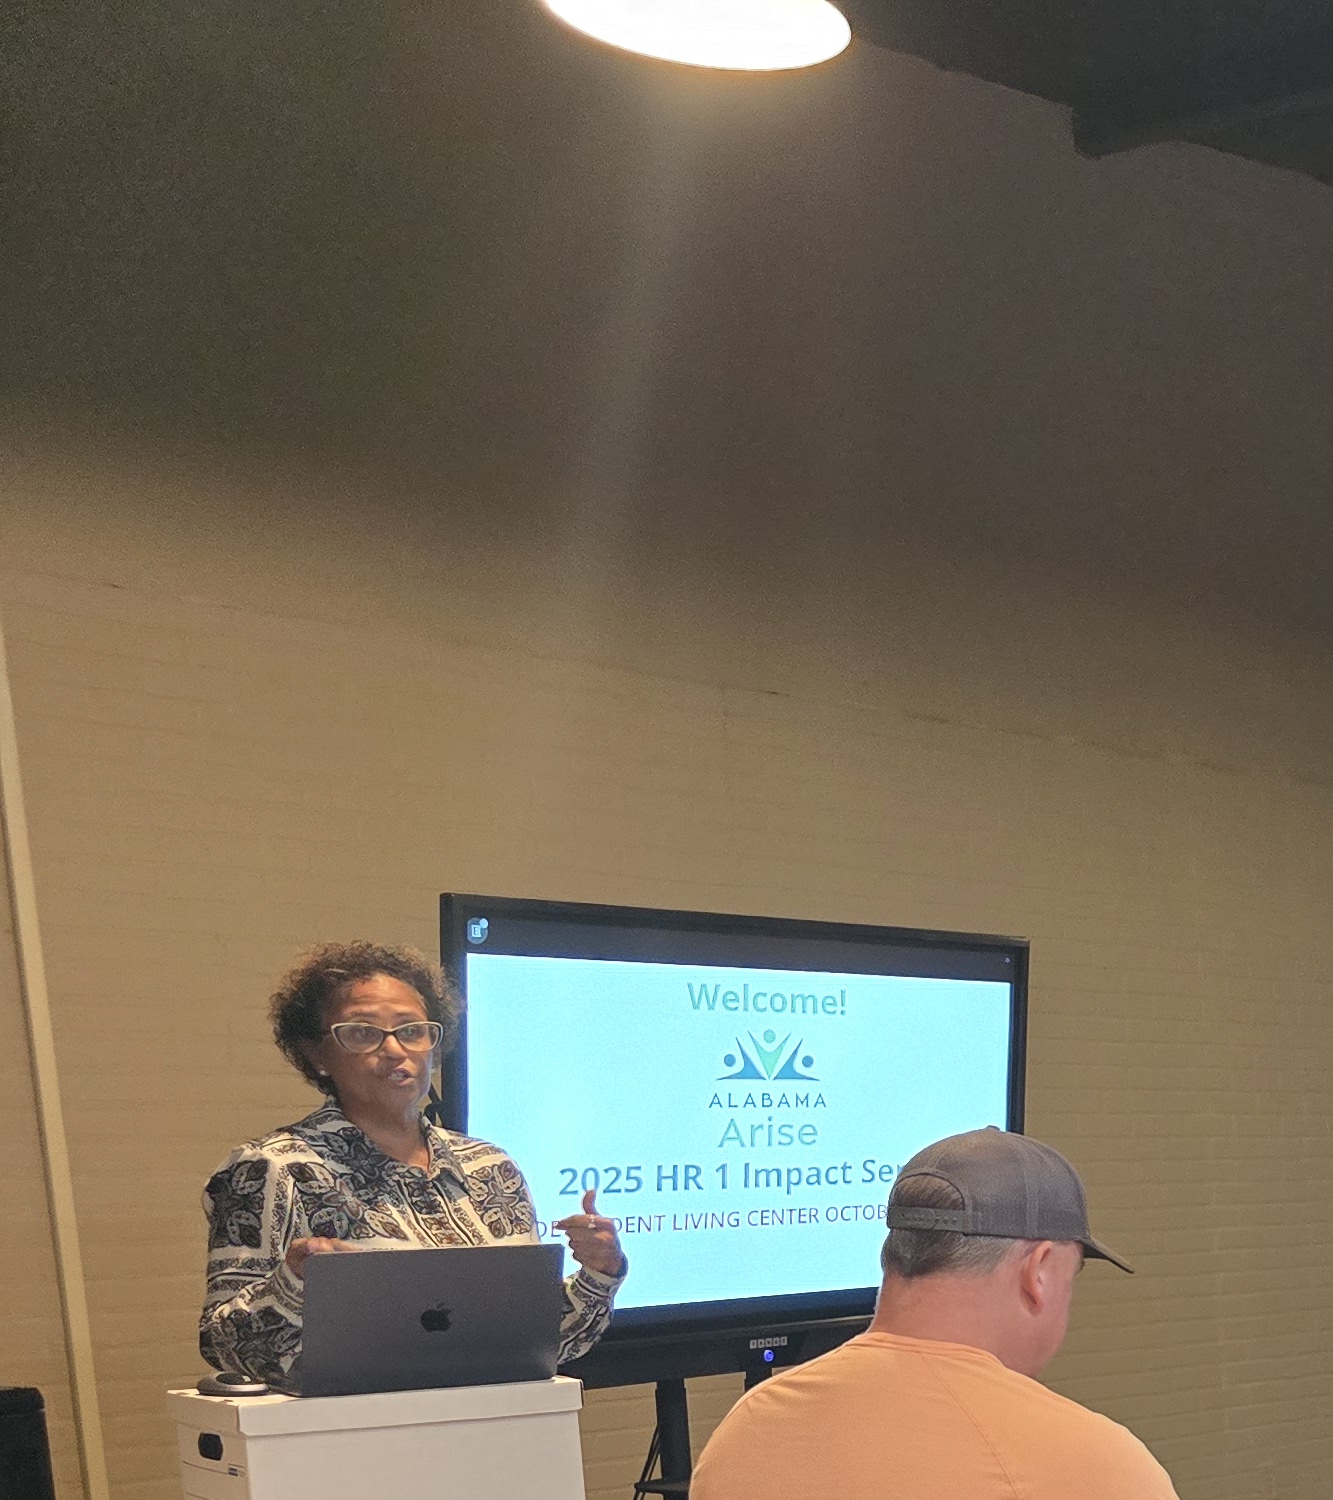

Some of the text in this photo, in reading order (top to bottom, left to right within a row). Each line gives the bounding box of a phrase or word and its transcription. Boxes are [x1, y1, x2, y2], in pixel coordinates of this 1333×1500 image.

[687, 982, 846, 1016] Welcome!
[708, 1092, 827, 1109] ALABAMA
[717, 1115, 818, 1148] Arise
[558, 1164, 644, 1196] 2025
[656, 1163, 704, 1192] HR
[714, 1162, 728, 1190] 1
[743, 1159, 852, 1195] Impact
[672, 1211, 740, 1231] LIVING
[747, 1207, 819, 1228] CENTER
[825, 1204, 887, 1224] OCTOB
